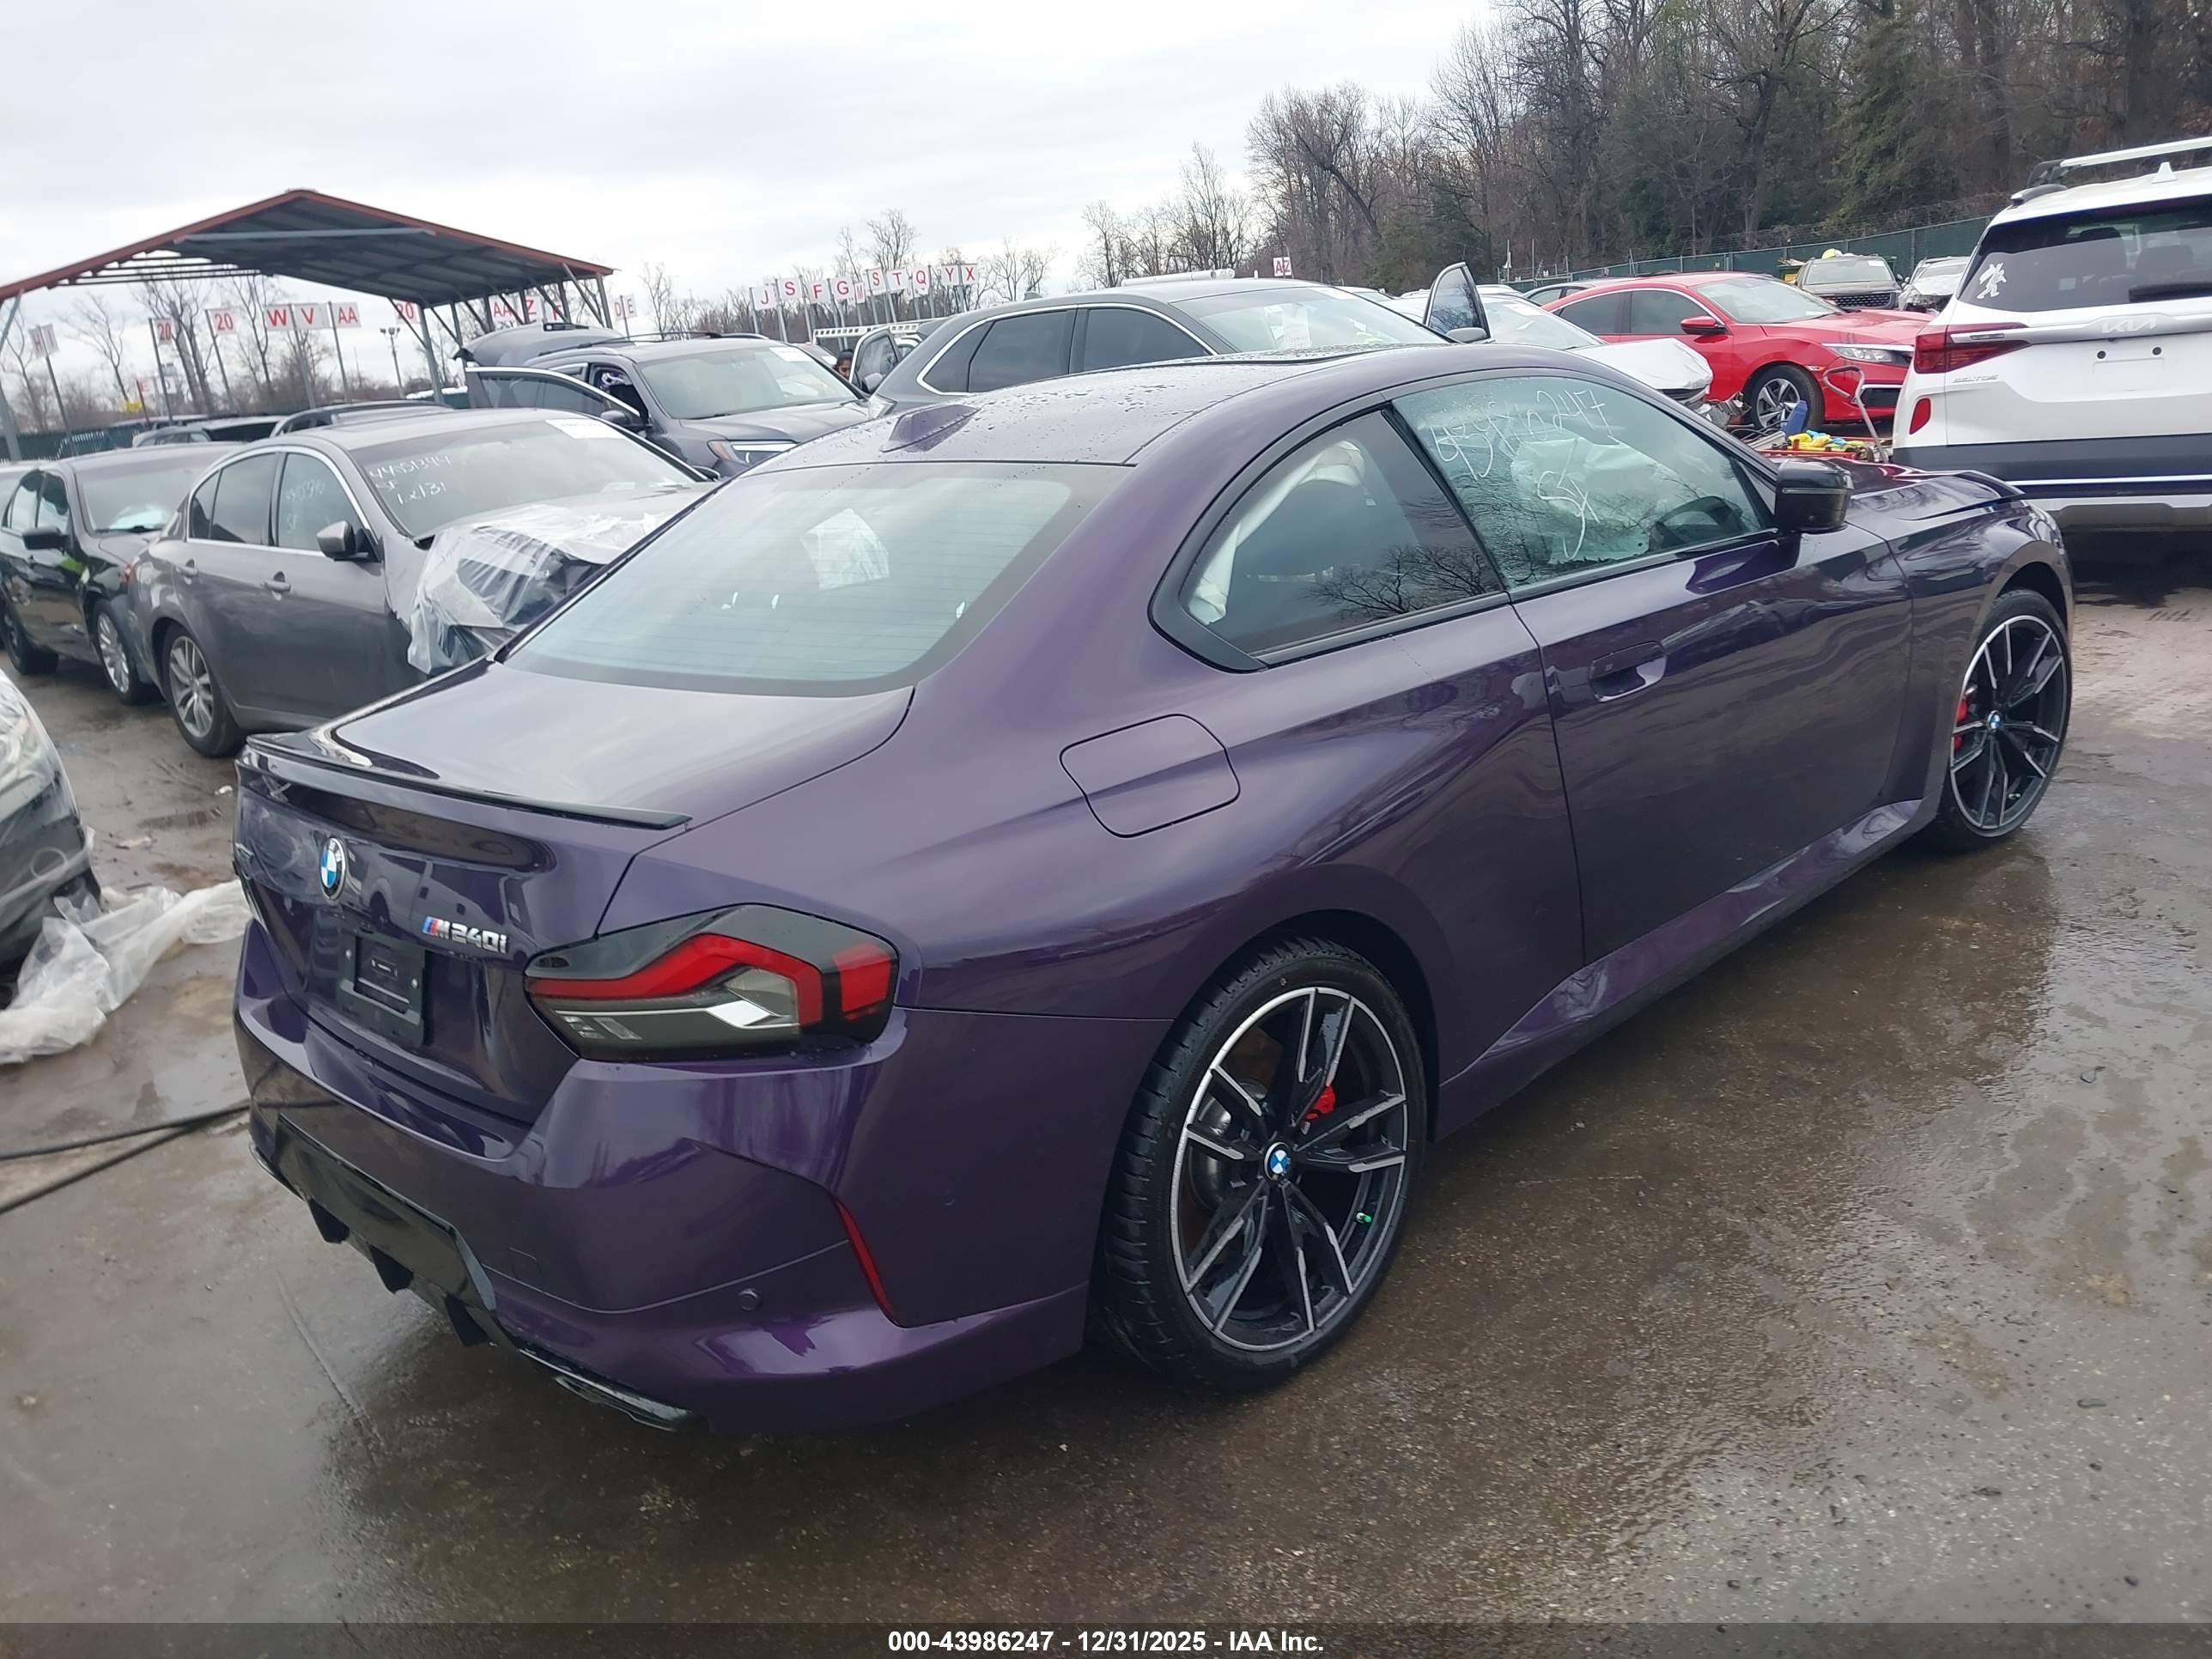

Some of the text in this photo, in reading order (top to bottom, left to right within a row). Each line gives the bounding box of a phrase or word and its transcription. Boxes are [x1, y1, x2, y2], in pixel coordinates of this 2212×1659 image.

[872, 271, 880, 286] S
[893, 271, 902, 285] T
[915, 270, 927, 284] Q
[945, 267, 954, 282] Y
[966, 267, 975, 281] X
[784, 281, 796, 295] S
[813, 284, 822, 299] F
[836, 280, 849, 295] G
[760, 289, 769, 305] J
[215, 313, 234, 331] 20
[267, 308, 288, 326] W
[301, 307, 314, 325] V
[338, 307, 358, 324] AA
[157, 322, 172, 341] 20
